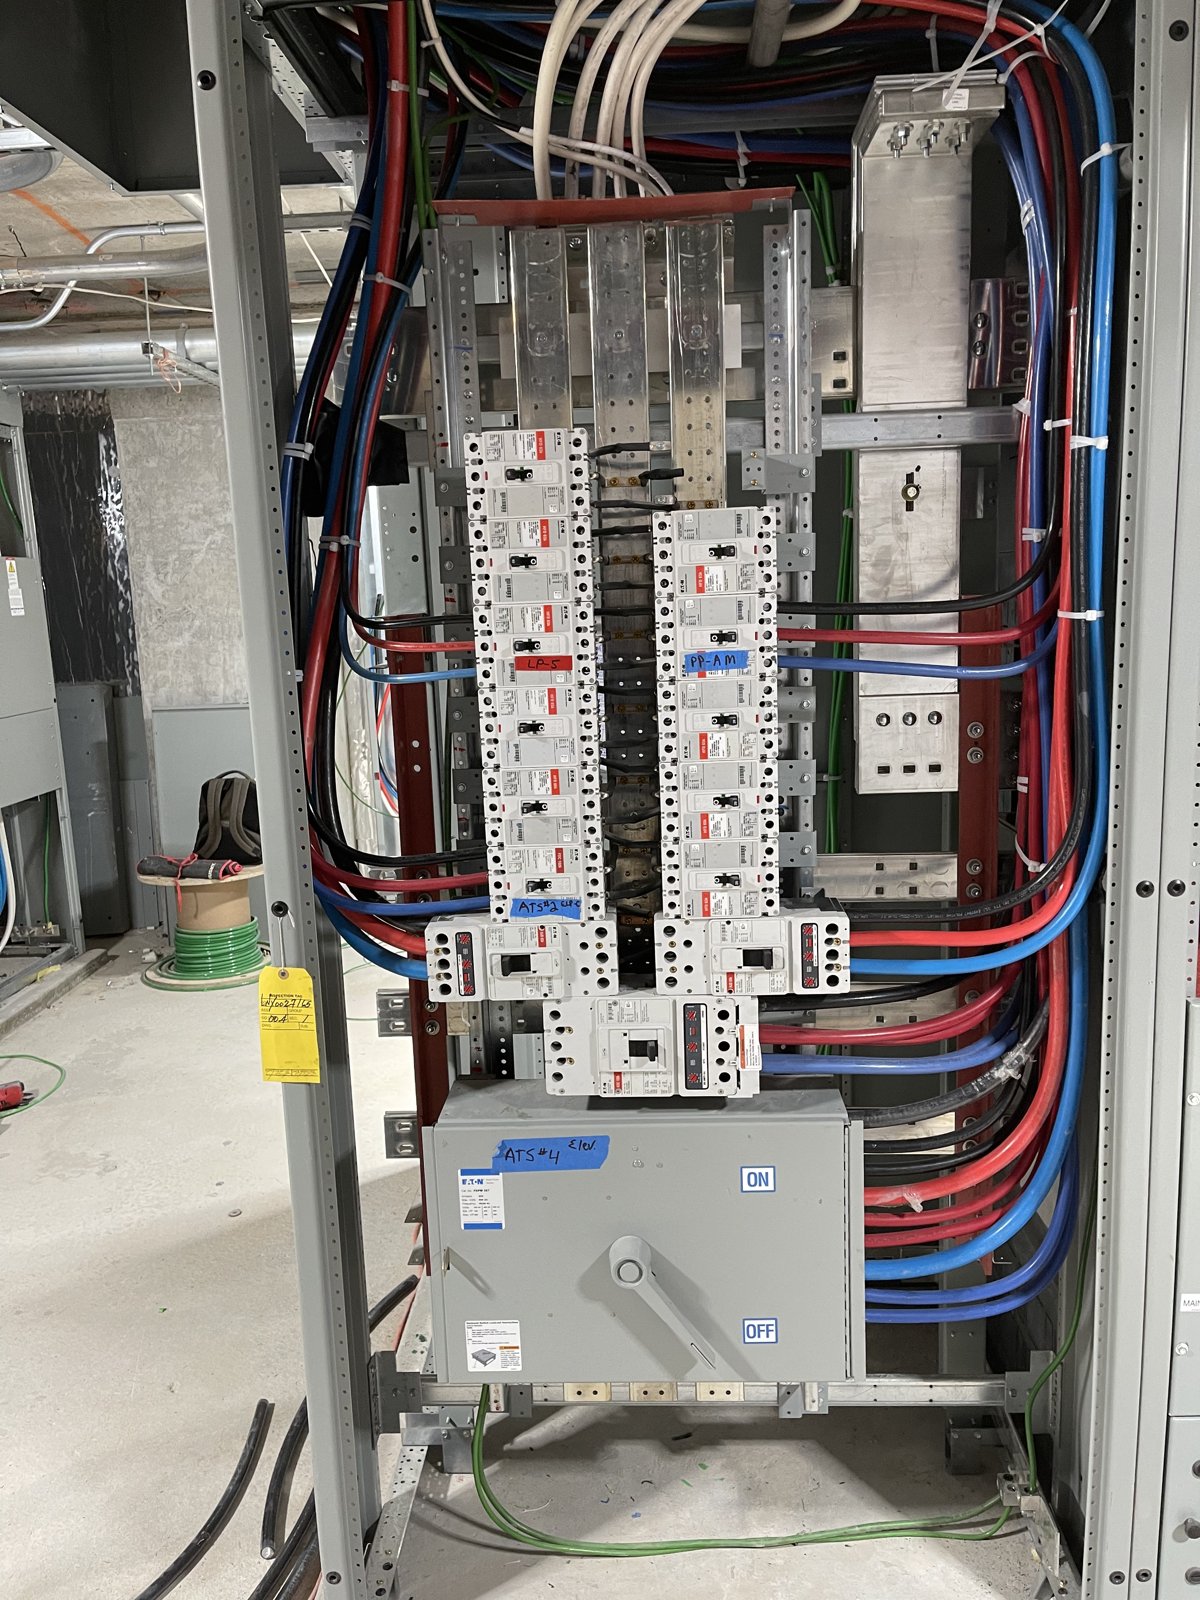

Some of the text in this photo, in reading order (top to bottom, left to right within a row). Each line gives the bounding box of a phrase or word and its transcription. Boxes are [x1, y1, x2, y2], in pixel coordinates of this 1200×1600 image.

[527, 658, 561, 670] LP-5
[518, 899, 559, 914] ATS#2
[461, 1178, 484, 1186] EATON
[747, 1171, 769, 1188] ON
[746, 1323, 774, 1339] OFF
